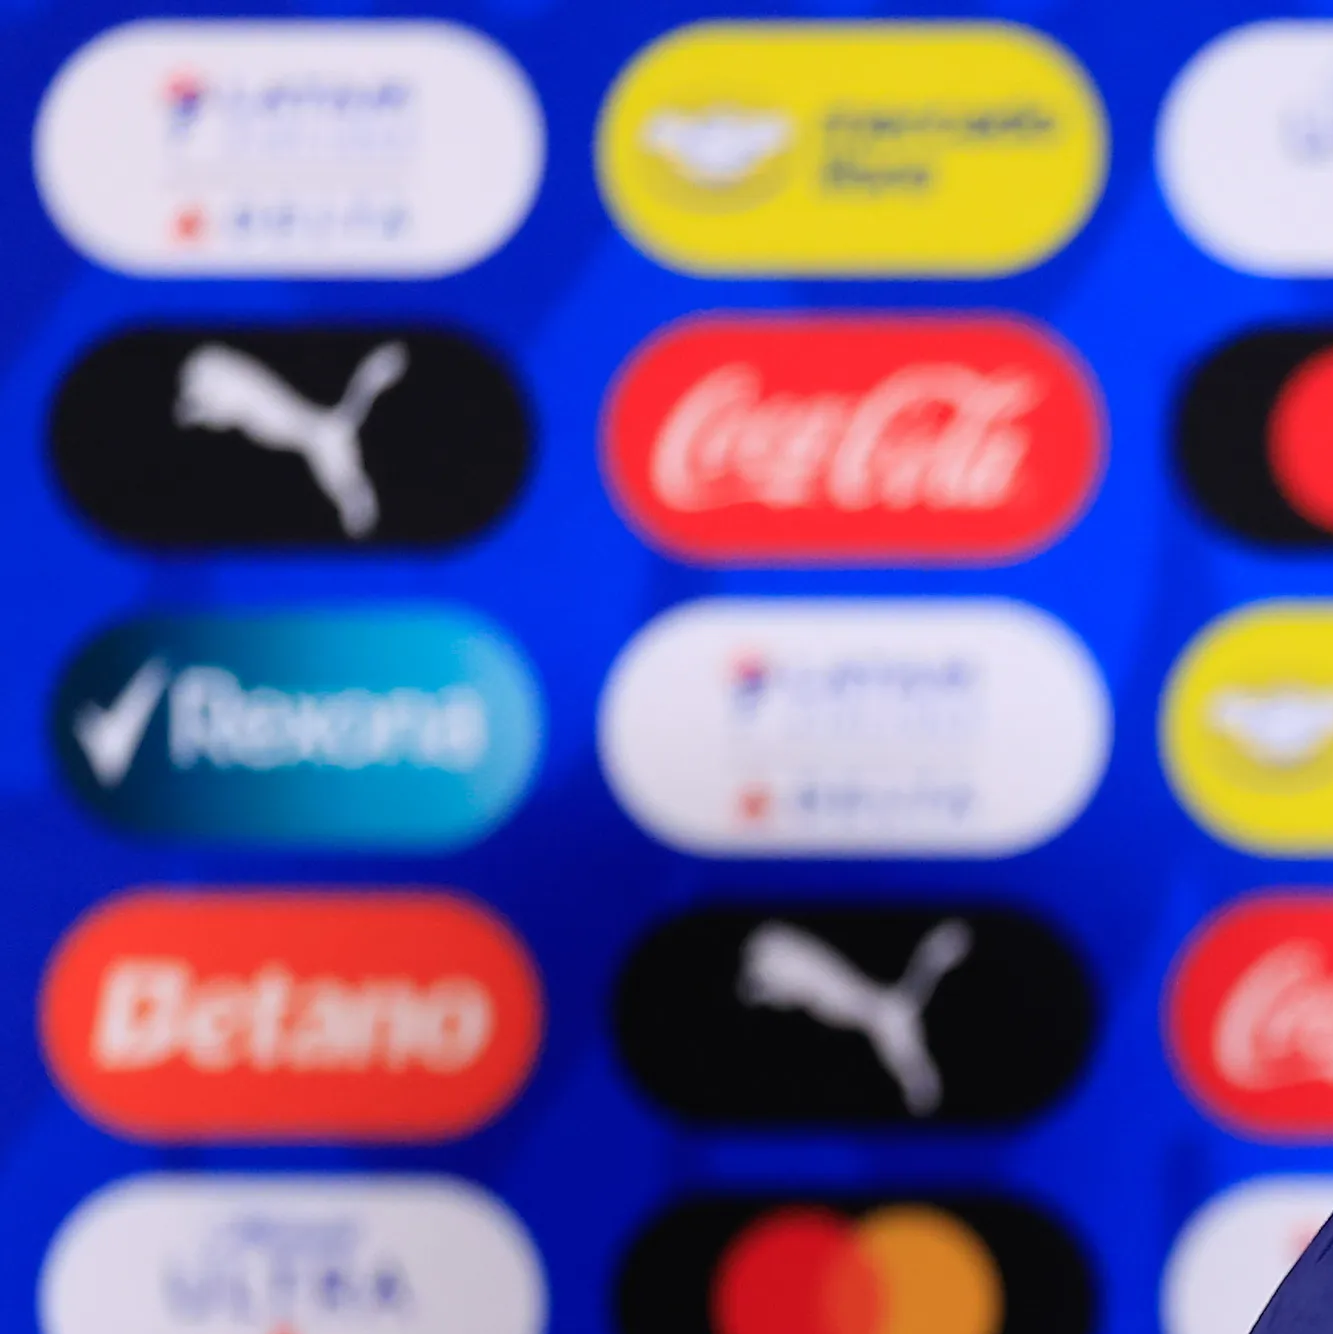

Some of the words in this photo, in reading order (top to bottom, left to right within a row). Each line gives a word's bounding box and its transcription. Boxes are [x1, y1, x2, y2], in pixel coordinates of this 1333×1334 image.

[819, 105, 1060, 146] mercado
[168, 666, 491, 772] Rexona
[91, 958, 491, 1069] Betano
[160, 1260, 412, 1318] ULTRA
